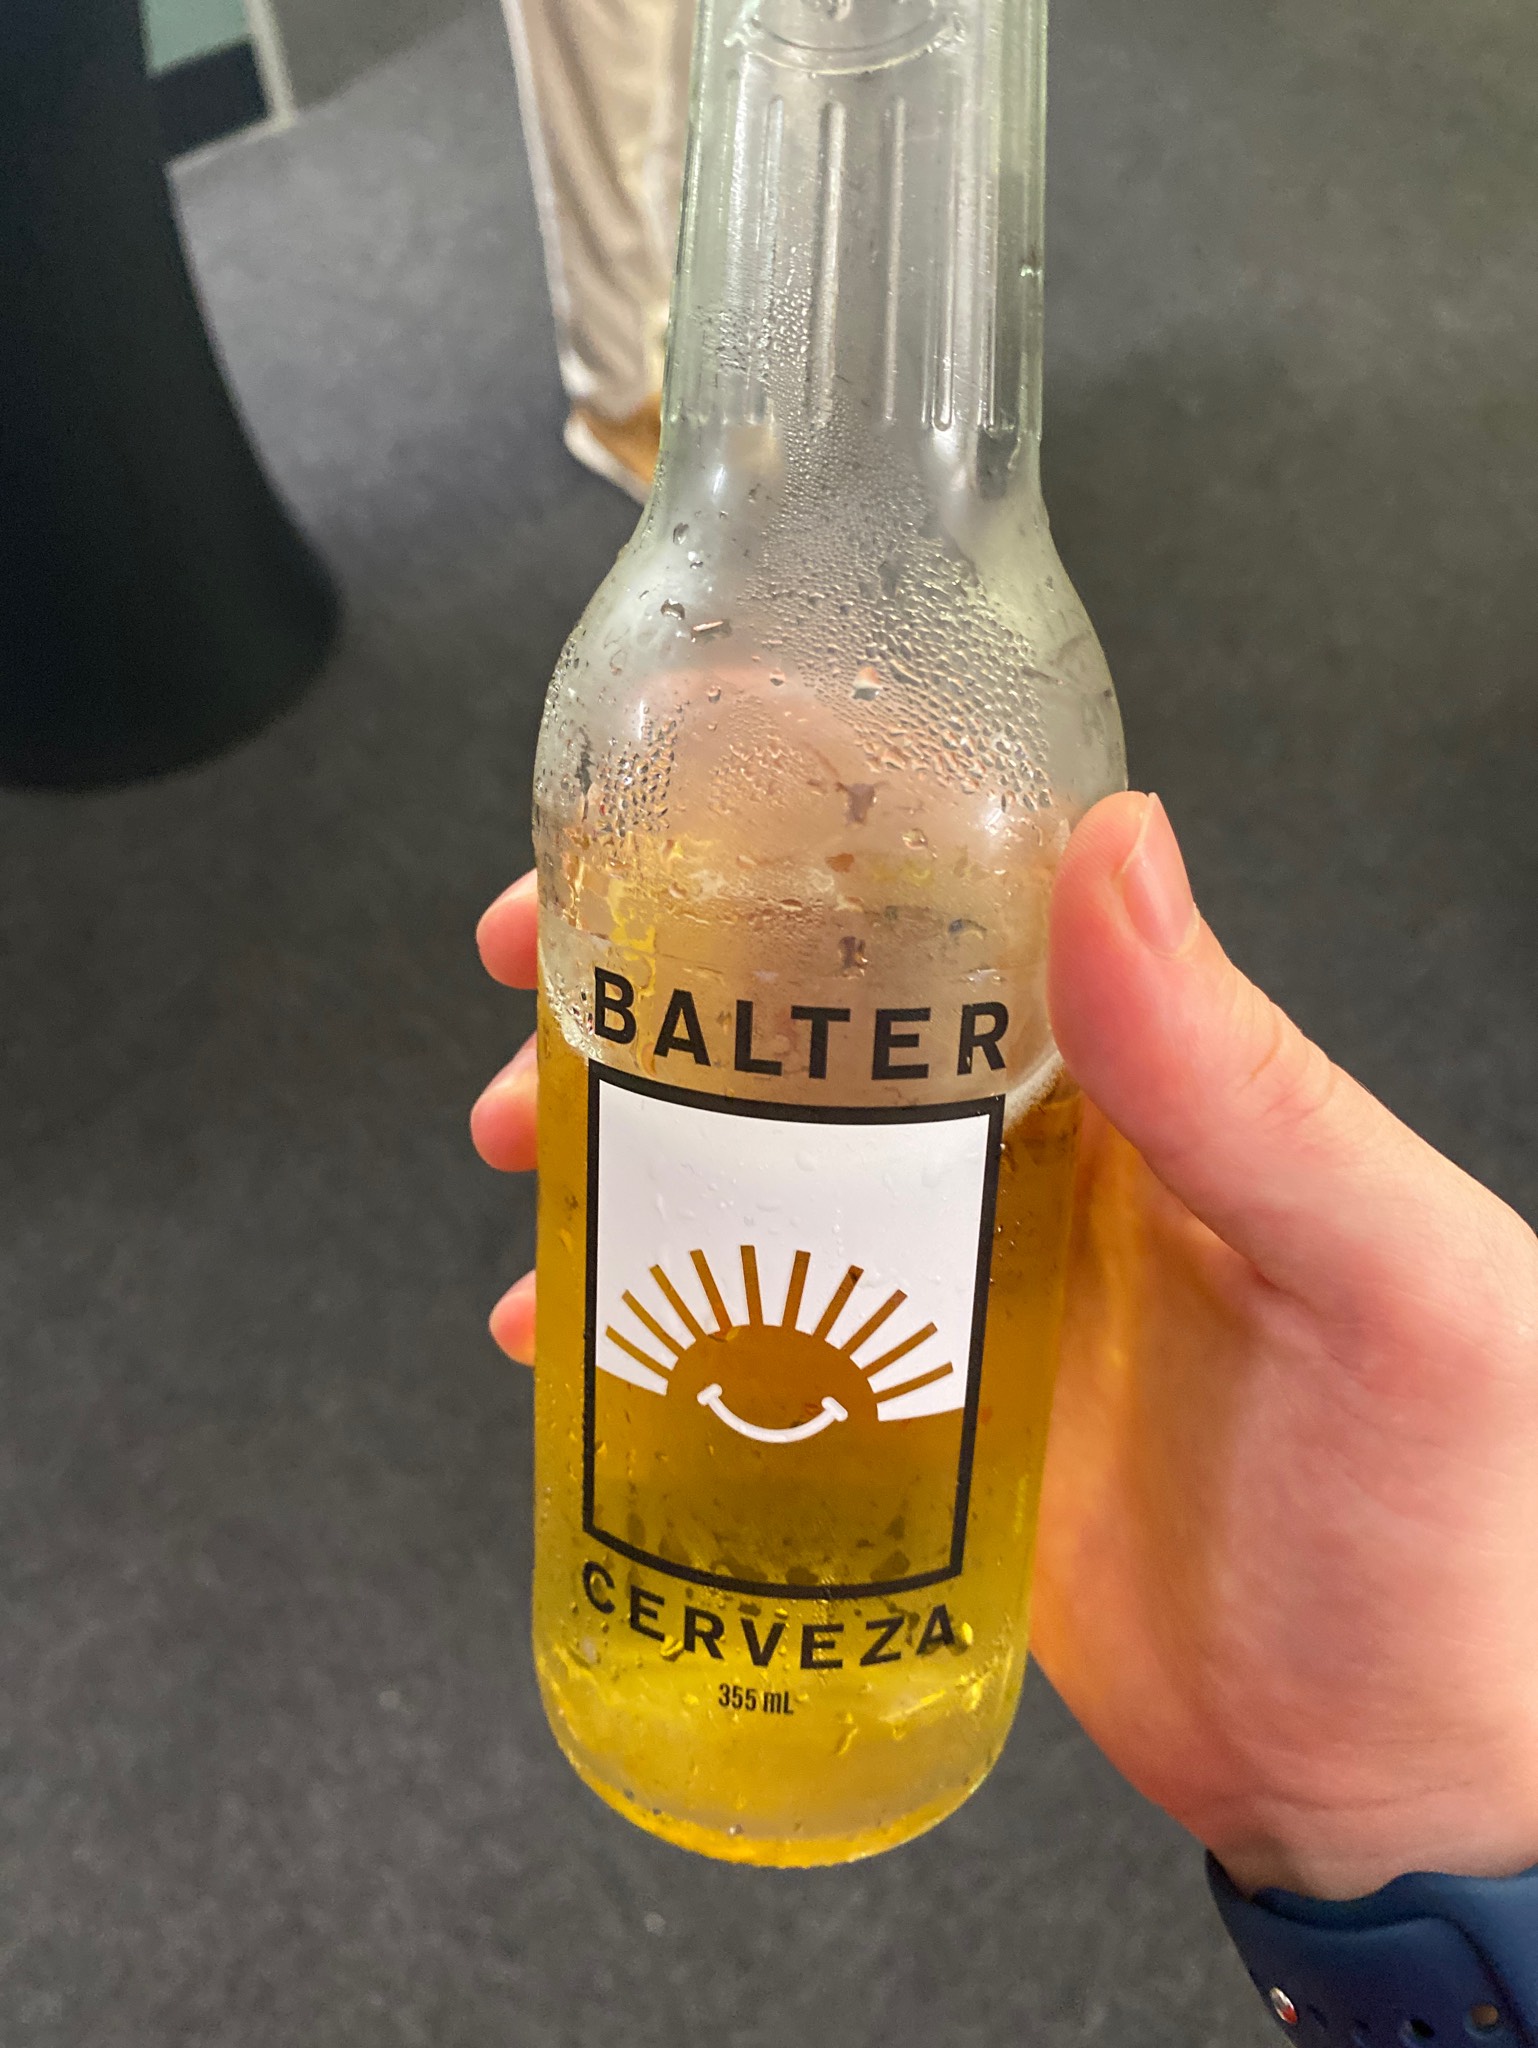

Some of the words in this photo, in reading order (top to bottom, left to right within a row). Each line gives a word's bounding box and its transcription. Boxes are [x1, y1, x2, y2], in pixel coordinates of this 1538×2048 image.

[594, 966, 1009, 1080] BALTER
[582, 1561, 956, 1670] CERVEZA
[718, 1683, 757, 1711] 355
[763, 1690, 795, 1716] mL
